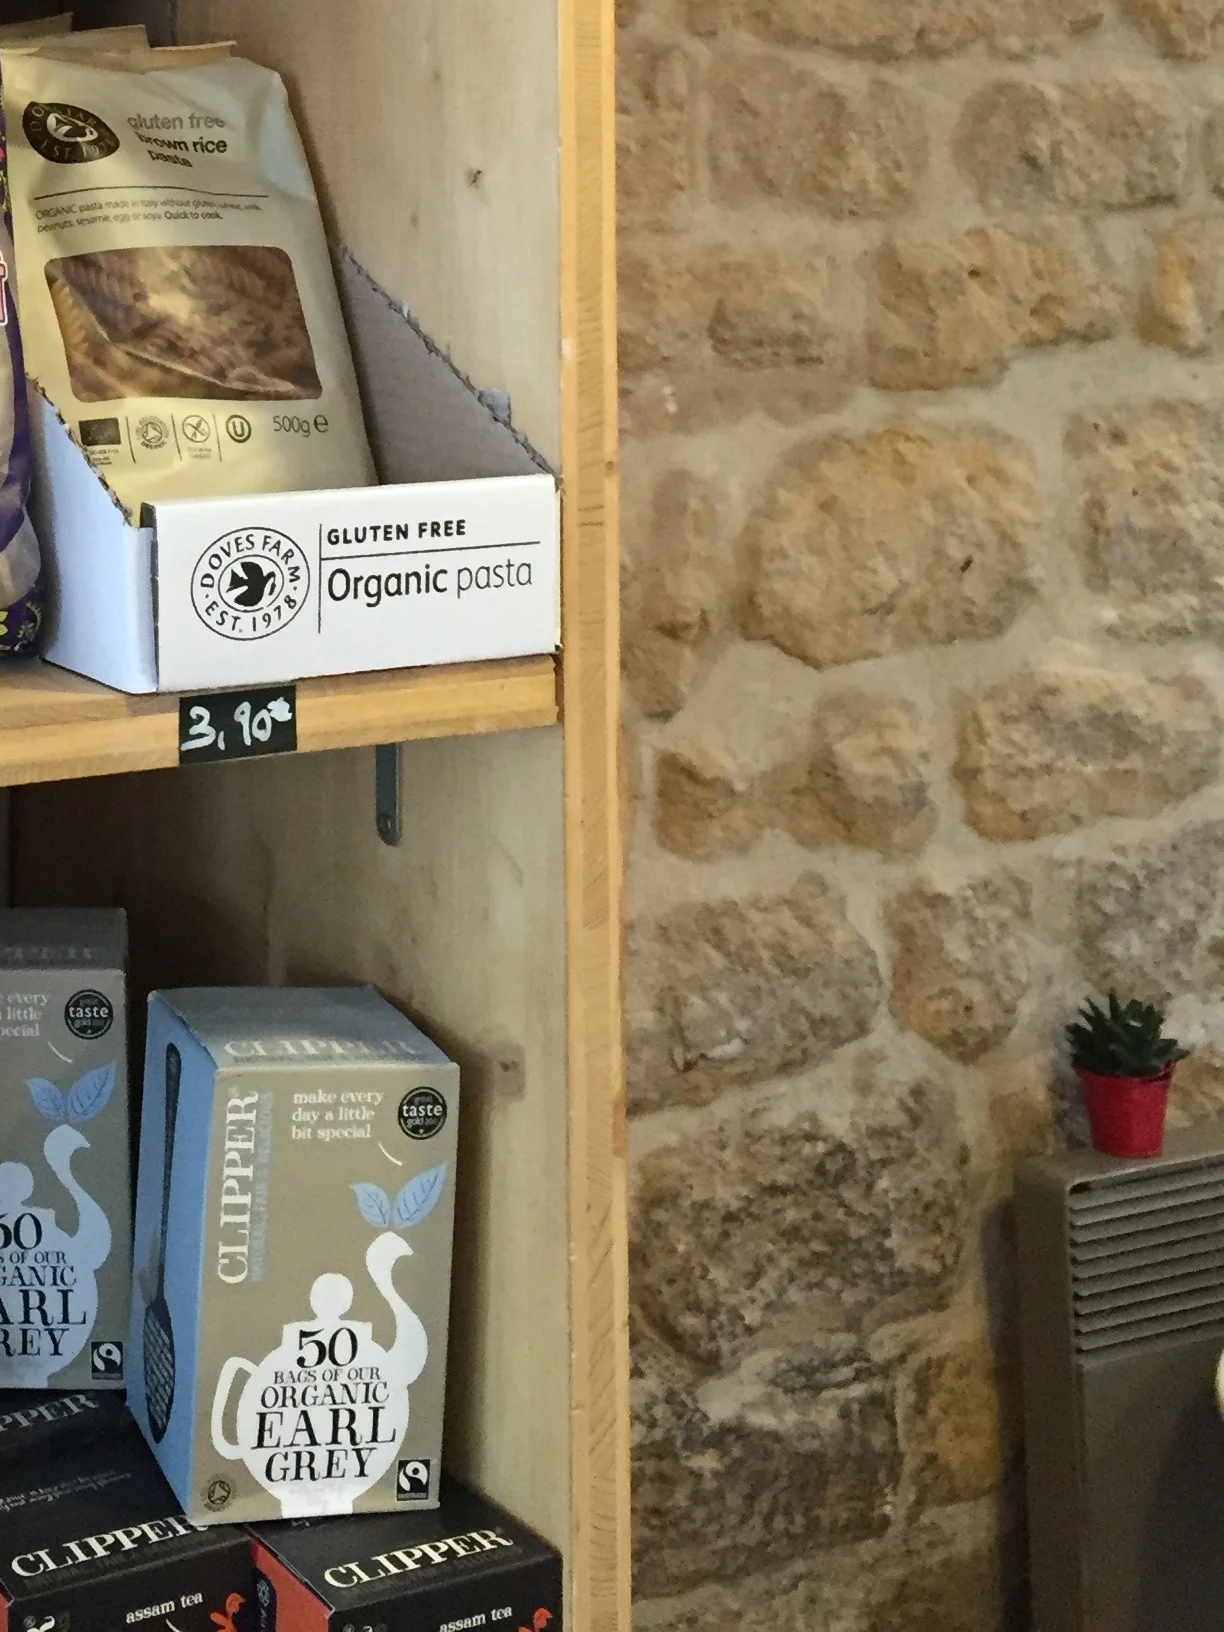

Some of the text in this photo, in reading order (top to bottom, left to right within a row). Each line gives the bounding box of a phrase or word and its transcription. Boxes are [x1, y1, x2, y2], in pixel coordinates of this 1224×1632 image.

[192, 135, 228, 155] rice
[148, 148, 193, 169] pasta
[272, 415, 312, 438] 500g
[327, 519, 466, 545] GLUTEN FREE
[200, 533, 302, 588] DOVES FARM
[327, 558, 533, 609] Organic pasta
[205, 596, 298, 633] EST. 1978
[7, 991, 51, 1007] every
[7, 1006, 43, 1021] little
[68, 1005, 110, 1019] taste
[293, 1089, 385, 1108] make every
[291, 1105, 376, 1125] day a little
[402, 1104, 444, 1118] taste
[291, 1123, 372, 1142] bit special
[217, 1088, 260, 1285] CLIPPER
[9, 1251, 28, 1264] OF
[34, 1251, 68, 1265] OUR
[296, 1326, 359, 1369] 50
[273, 1366, 381, 1386] BAGS OF OUR
[260, 1380, 390, 1409] ORGANIC
[251, 1405, 396, 1450] EARL
[264, 1447, 377, 1483] GREY
[323, 1528, 515, 1589] CLIPPER
[125, 1591, 204, 1625] assam tea
[490, 1605, 514, 1622] tea
